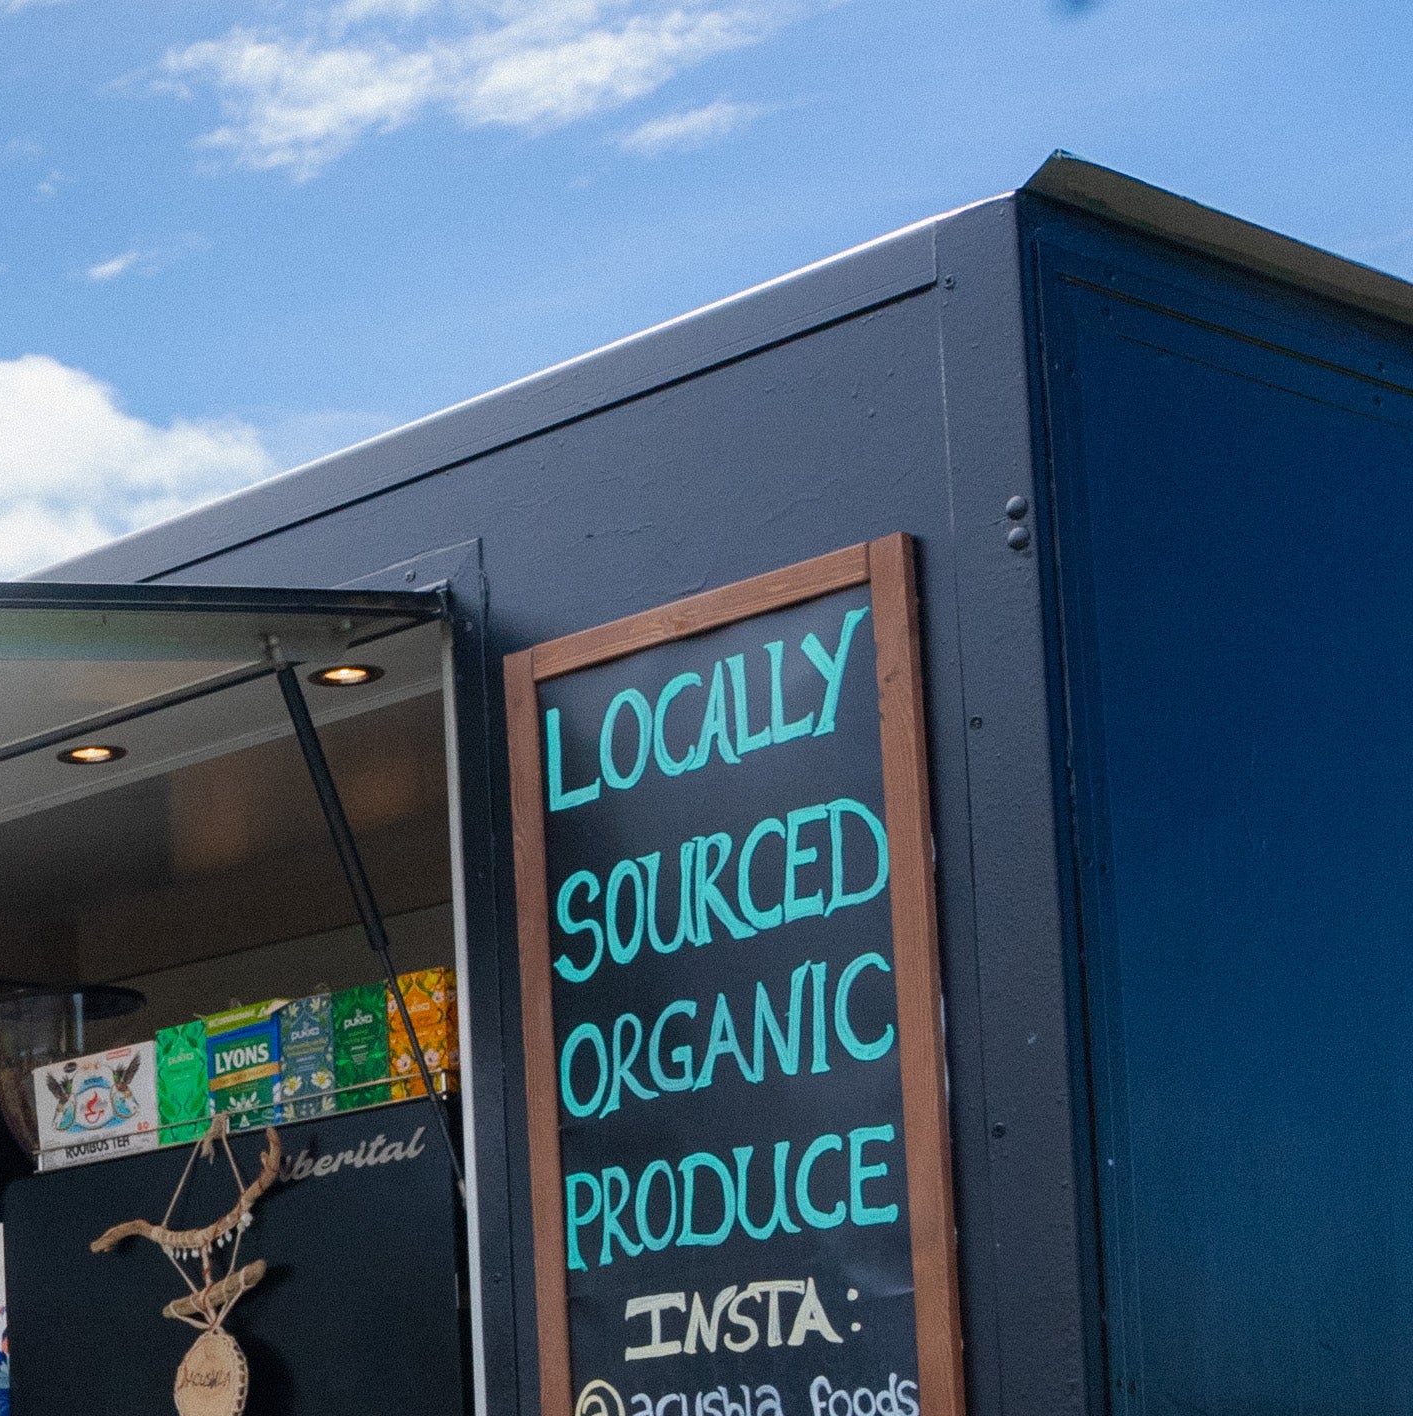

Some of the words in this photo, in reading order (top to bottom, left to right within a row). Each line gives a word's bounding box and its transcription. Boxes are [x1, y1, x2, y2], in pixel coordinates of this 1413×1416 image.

[545, 606, 870, 812] LOCALLY
[553, 798, 890, 983] SOURCED
[215, 1043, 269, 1075] LYONS
[560, 952, 895, 1119] ORGANIC
[65, 1139, 111, 1160] ROOIBOS
[112, 1135, 132, 1151] TEA
[565, 1124, 900, 1271] PRODUCE
[624, 1277, 862, 1361] INSTA:
